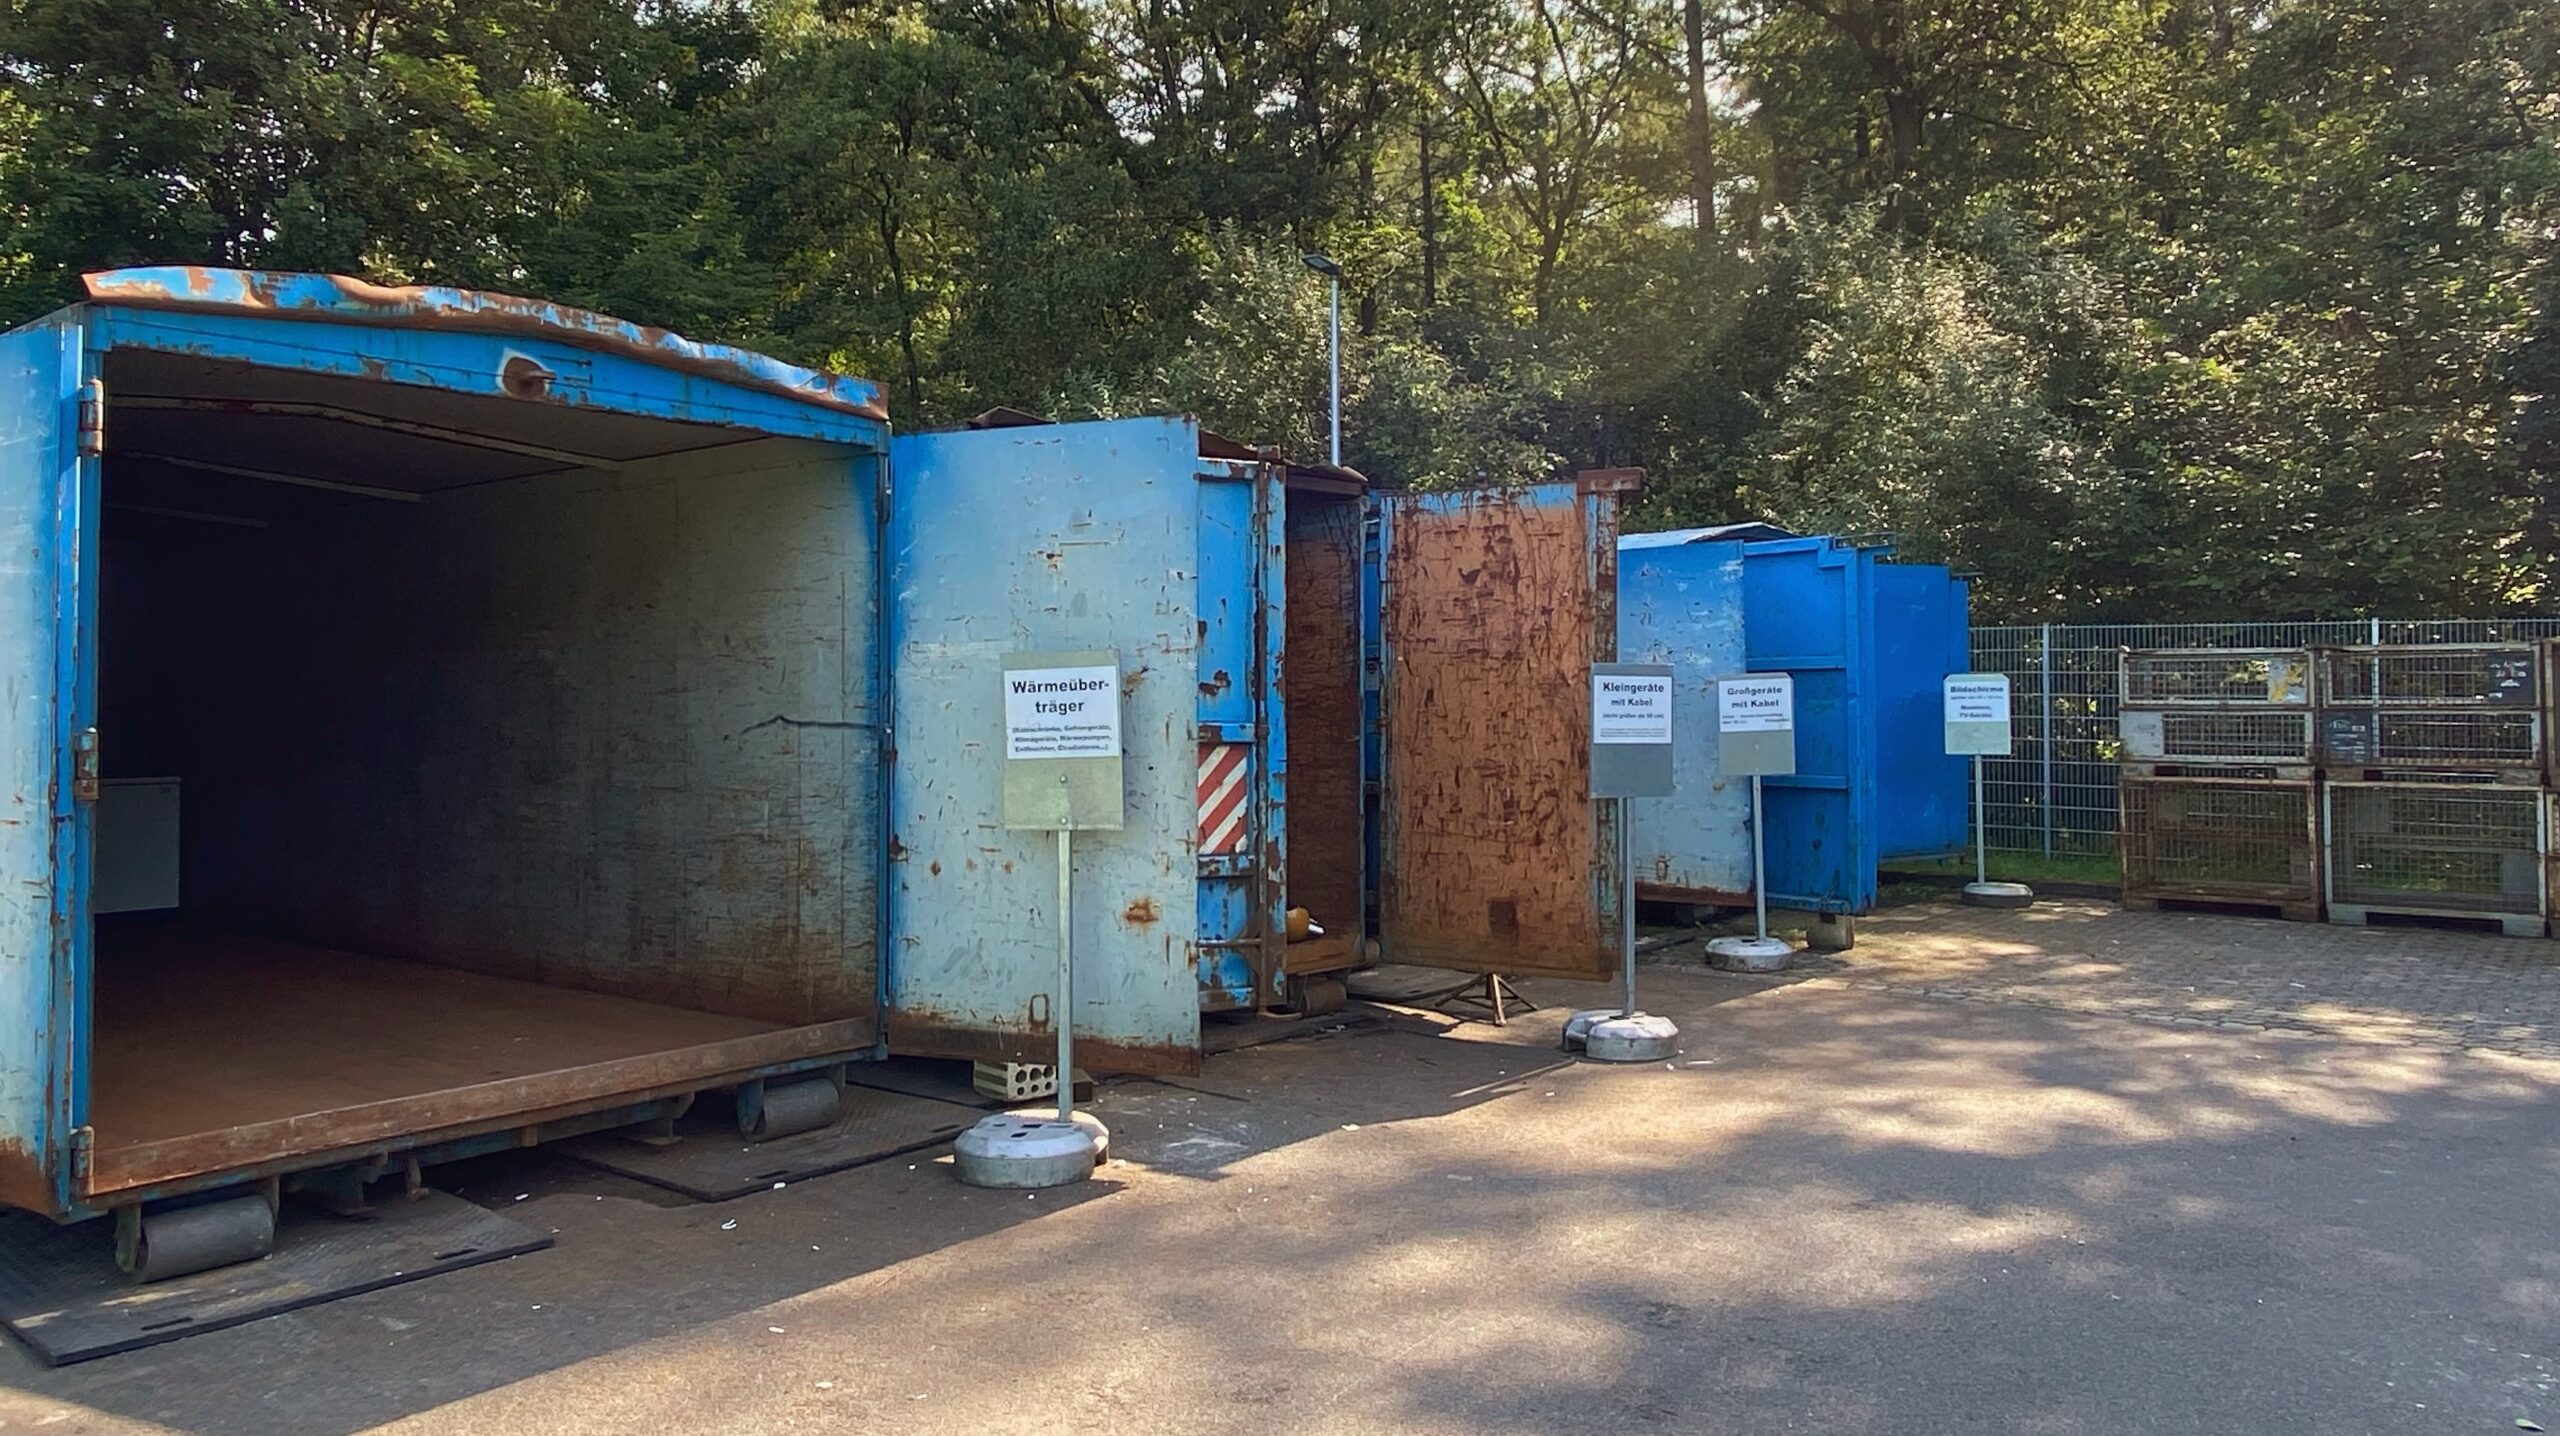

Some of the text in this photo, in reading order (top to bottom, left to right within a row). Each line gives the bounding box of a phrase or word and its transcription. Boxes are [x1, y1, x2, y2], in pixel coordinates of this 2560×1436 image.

[1012, 678, 1109, 694] Wärmeüber-
[1603, 682, 1664, 695] Kleingeräte
[1727, 686, 1782, 696] Großgeräte
[1035, 700, 1085, 715] träger
[1611, 698, 1653, 706] mit Kabel
[1751, 699, 1779, 707] Kabel
